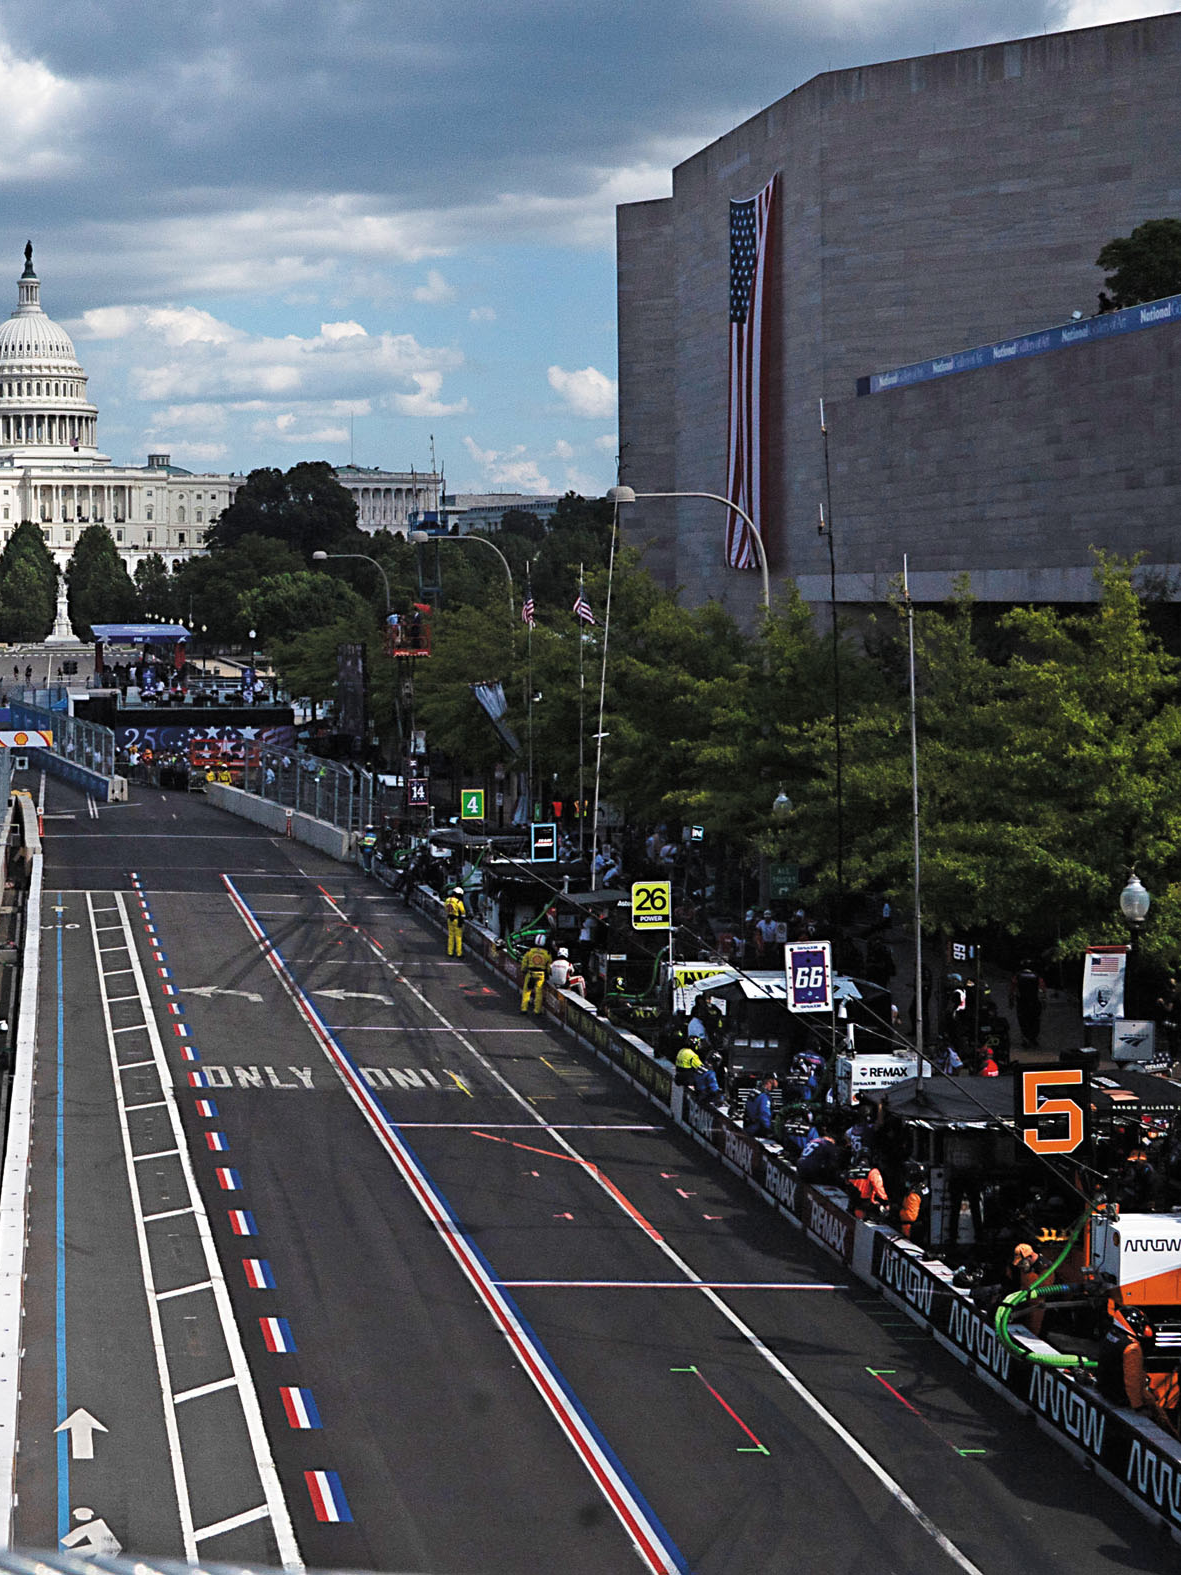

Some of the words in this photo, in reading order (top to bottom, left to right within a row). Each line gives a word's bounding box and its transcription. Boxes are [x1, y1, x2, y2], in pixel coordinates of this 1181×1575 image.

[1140, 303, 1171, 324] National
[411, 786, 425, 798] 14
[466, 796, 479, 813] 4
[635, 888, 667, 911] 26
[953, 943, 965, 960] 66
[795, 966, 823, 988] 66
[202, 1066, 315, 1089] ONLY
[1023, 1069, 1084, 1154] 5
[879, 1250, 934, 1316] ARROW
[949, 1300, 1011, 1382] ARROW
[1029, 1365, 1105, 1455] ARROW
